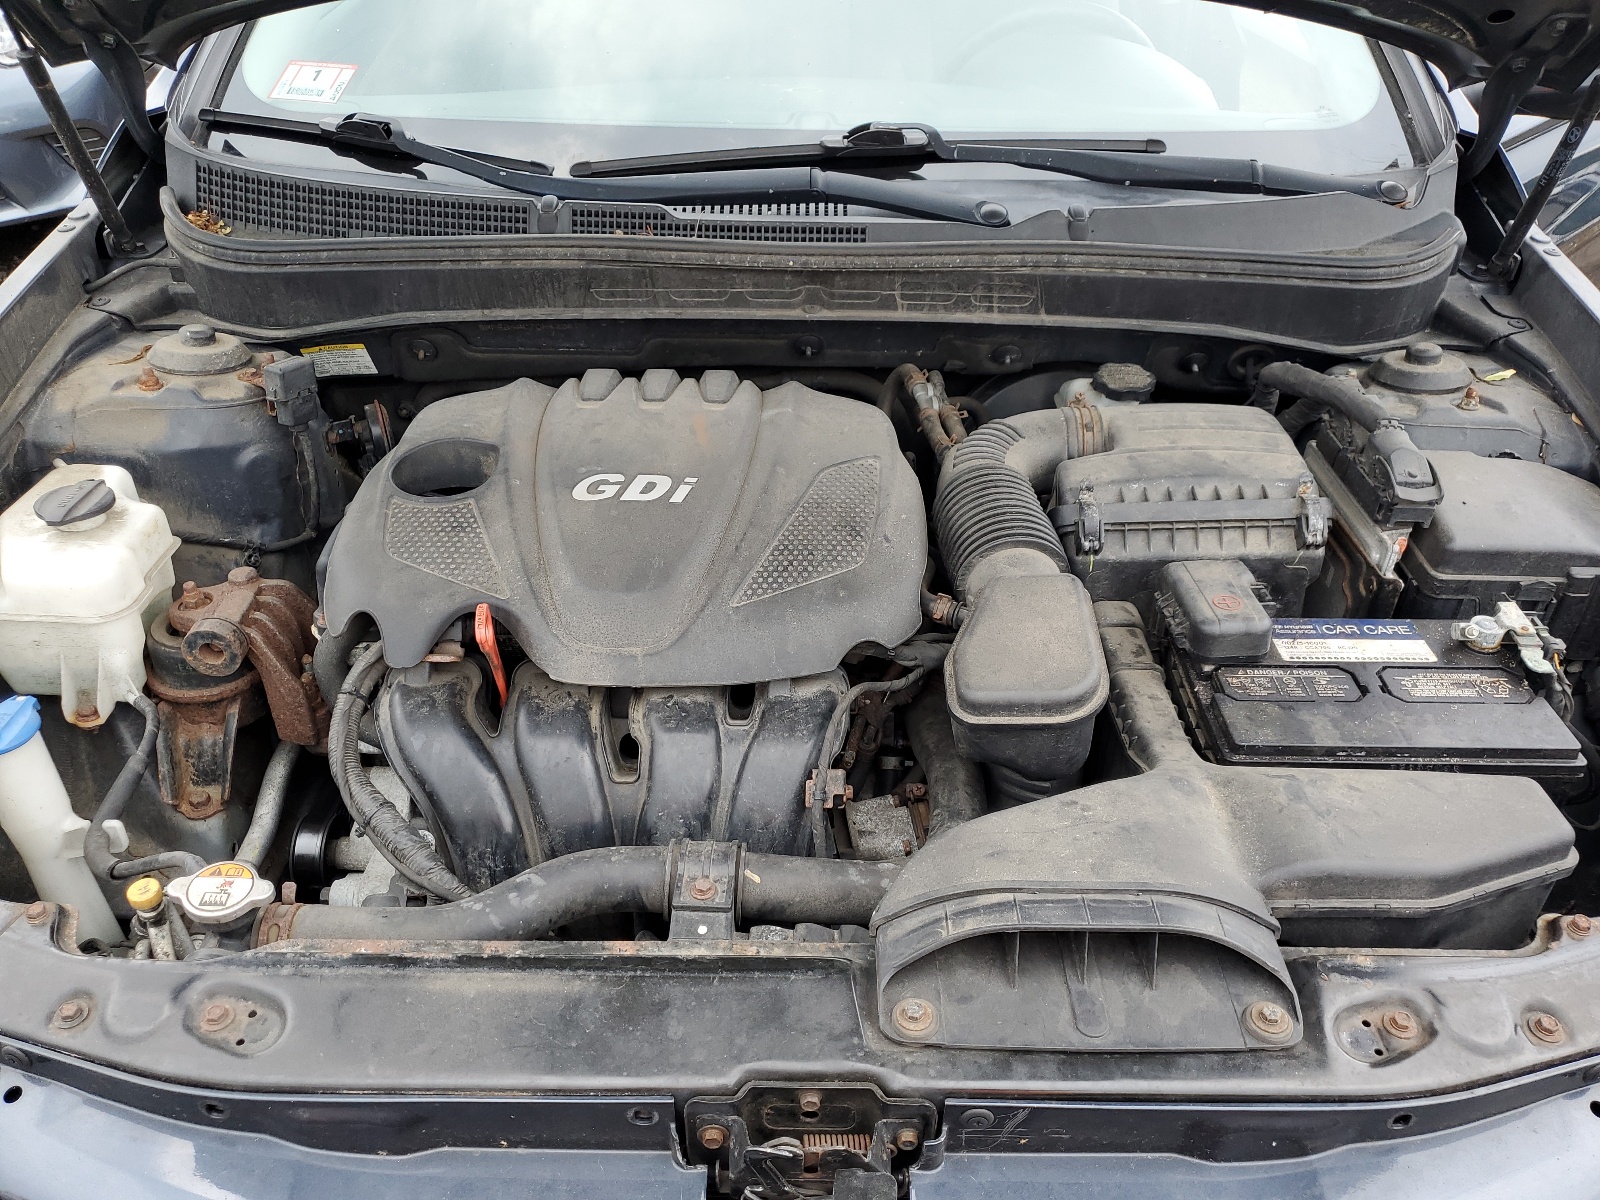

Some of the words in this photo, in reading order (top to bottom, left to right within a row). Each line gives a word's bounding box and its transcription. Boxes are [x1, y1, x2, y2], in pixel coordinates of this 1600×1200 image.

[312, 69, 323, 82] 1
[571, 473, 700, 503] GDi
[1322, 624, 1361, 635] CAR
[1363, 624, 1413, 635] CARE
